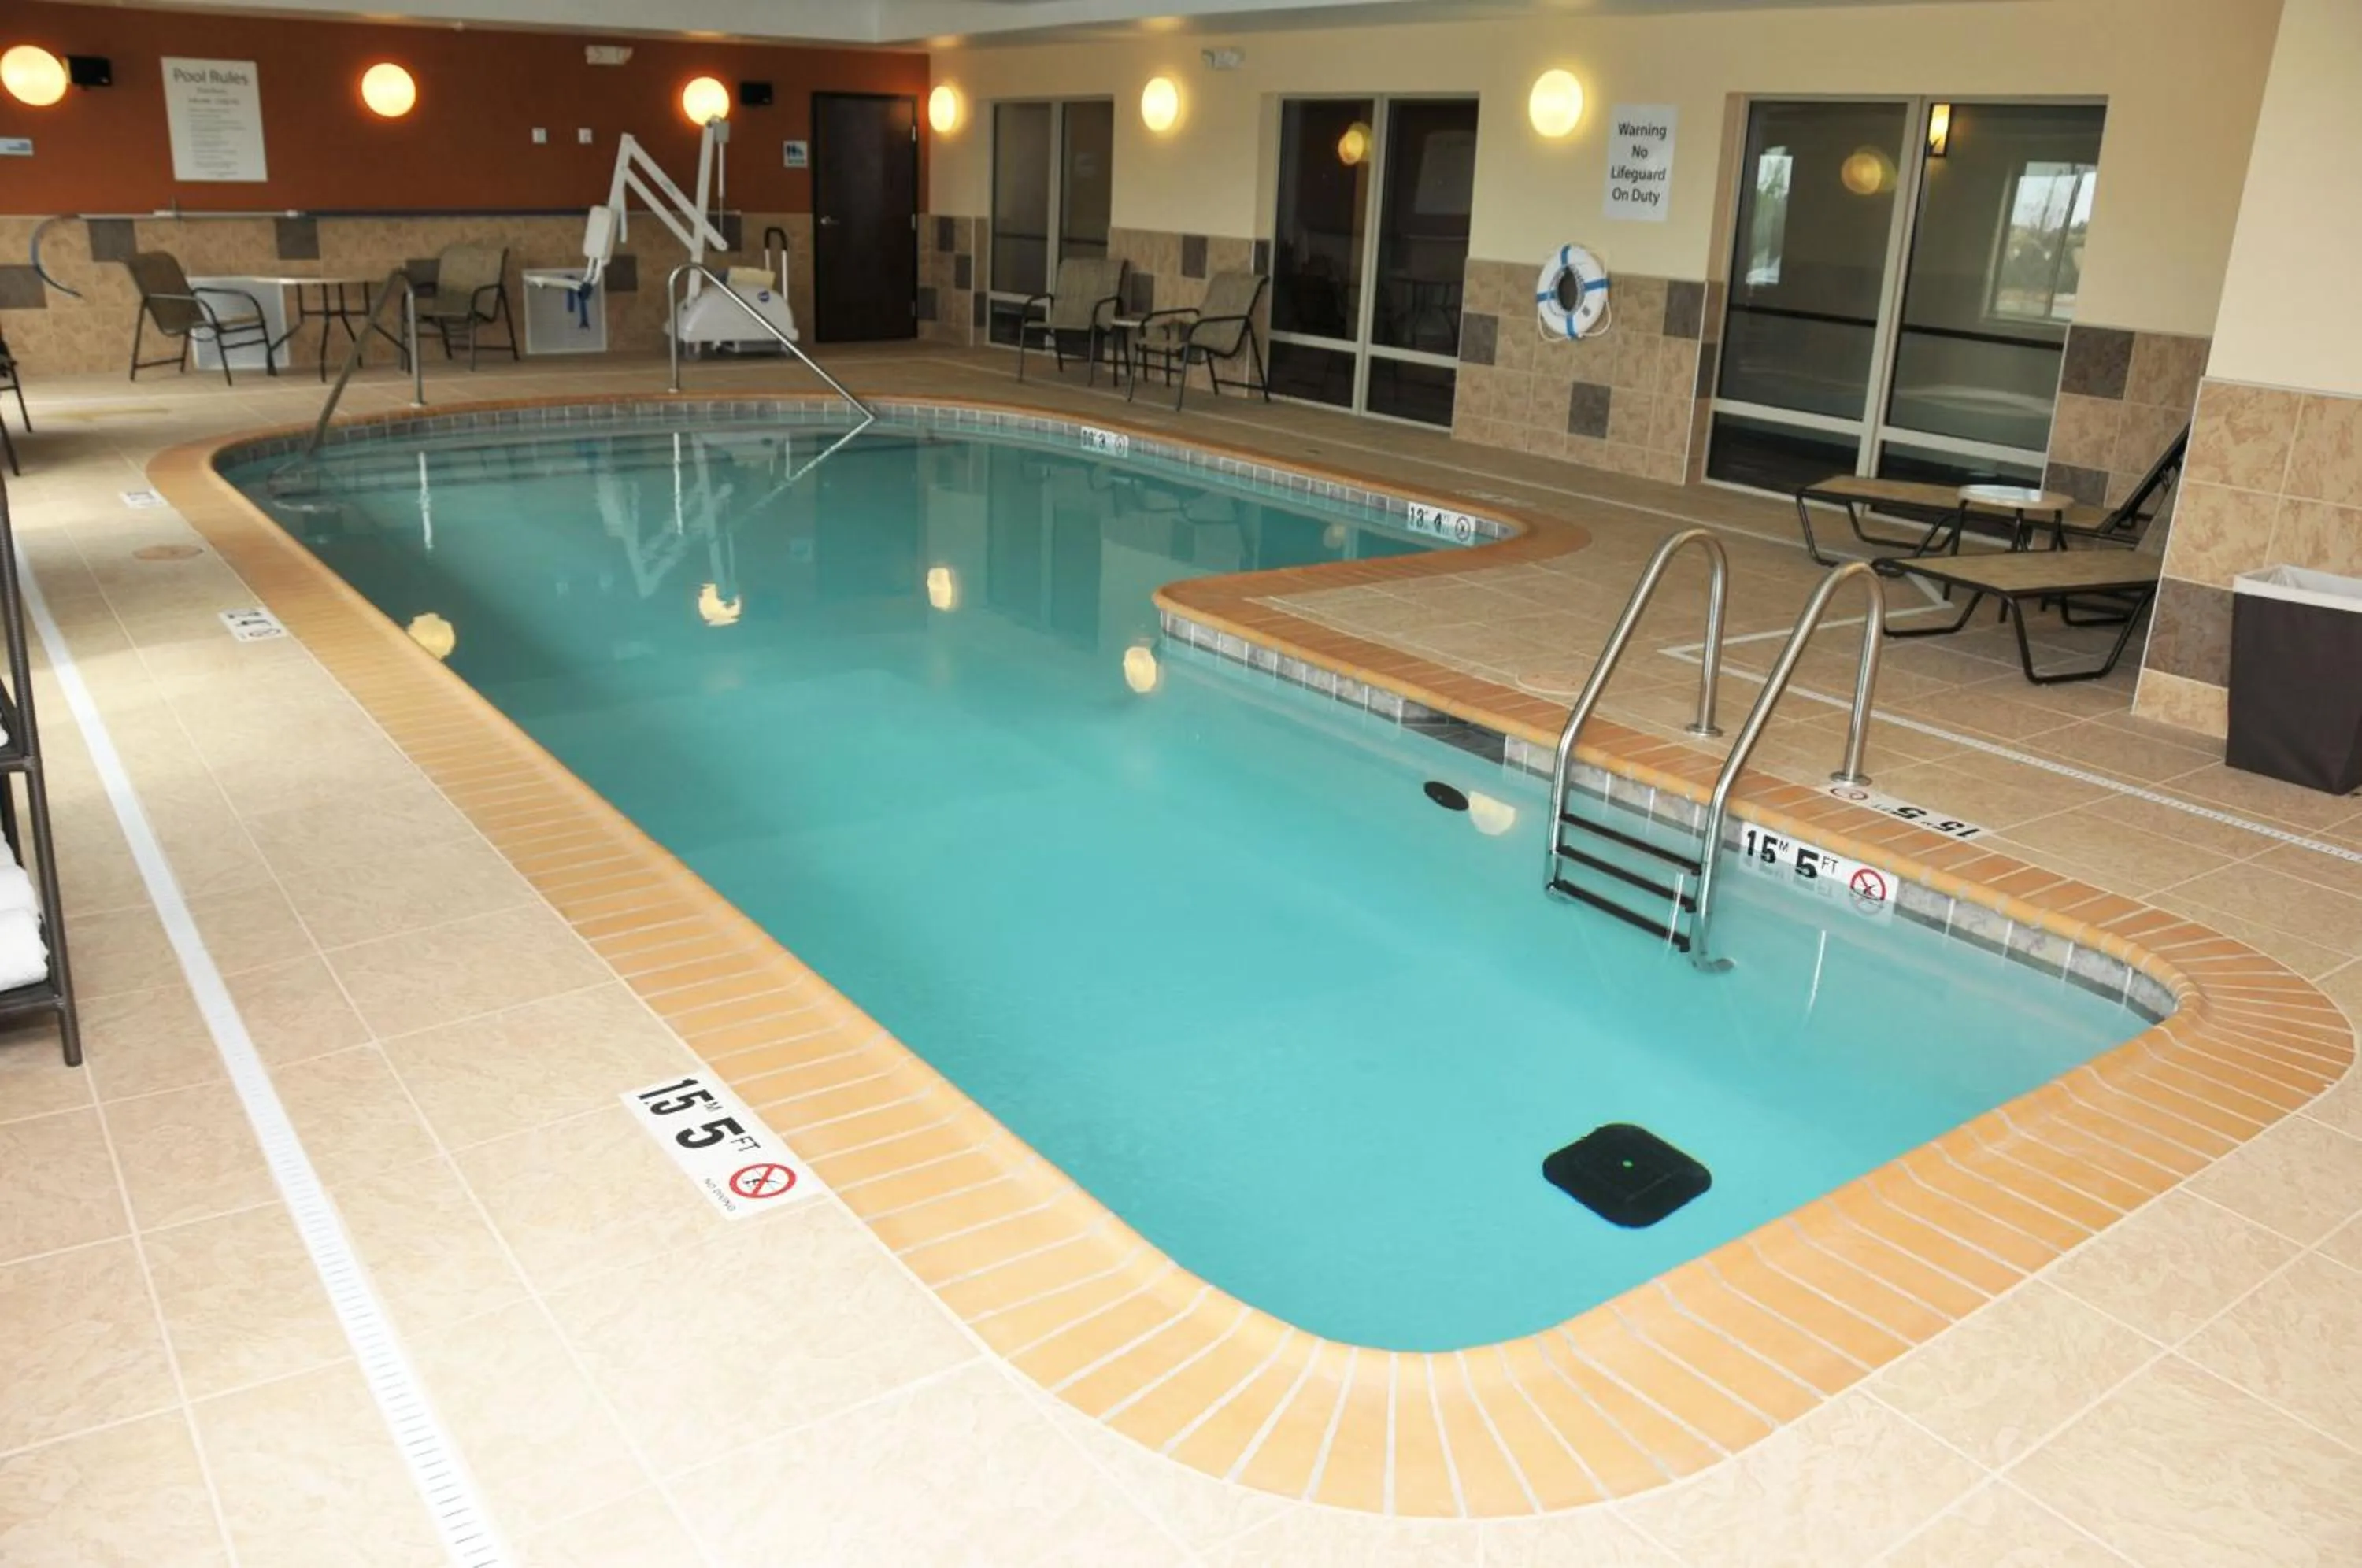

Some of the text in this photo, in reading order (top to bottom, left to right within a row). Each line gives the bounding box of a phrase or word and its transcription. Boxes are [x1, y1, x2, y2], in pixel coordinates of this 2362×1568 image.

[172, 66, 249, 86] Pool Rules
[1618, 122, 1668, 140] Warning
[1631, 144, 1649, 159] No
[1611, 165, 1667, 183] Lifeguard
[1612, 187, 1660, 206] On Duty
